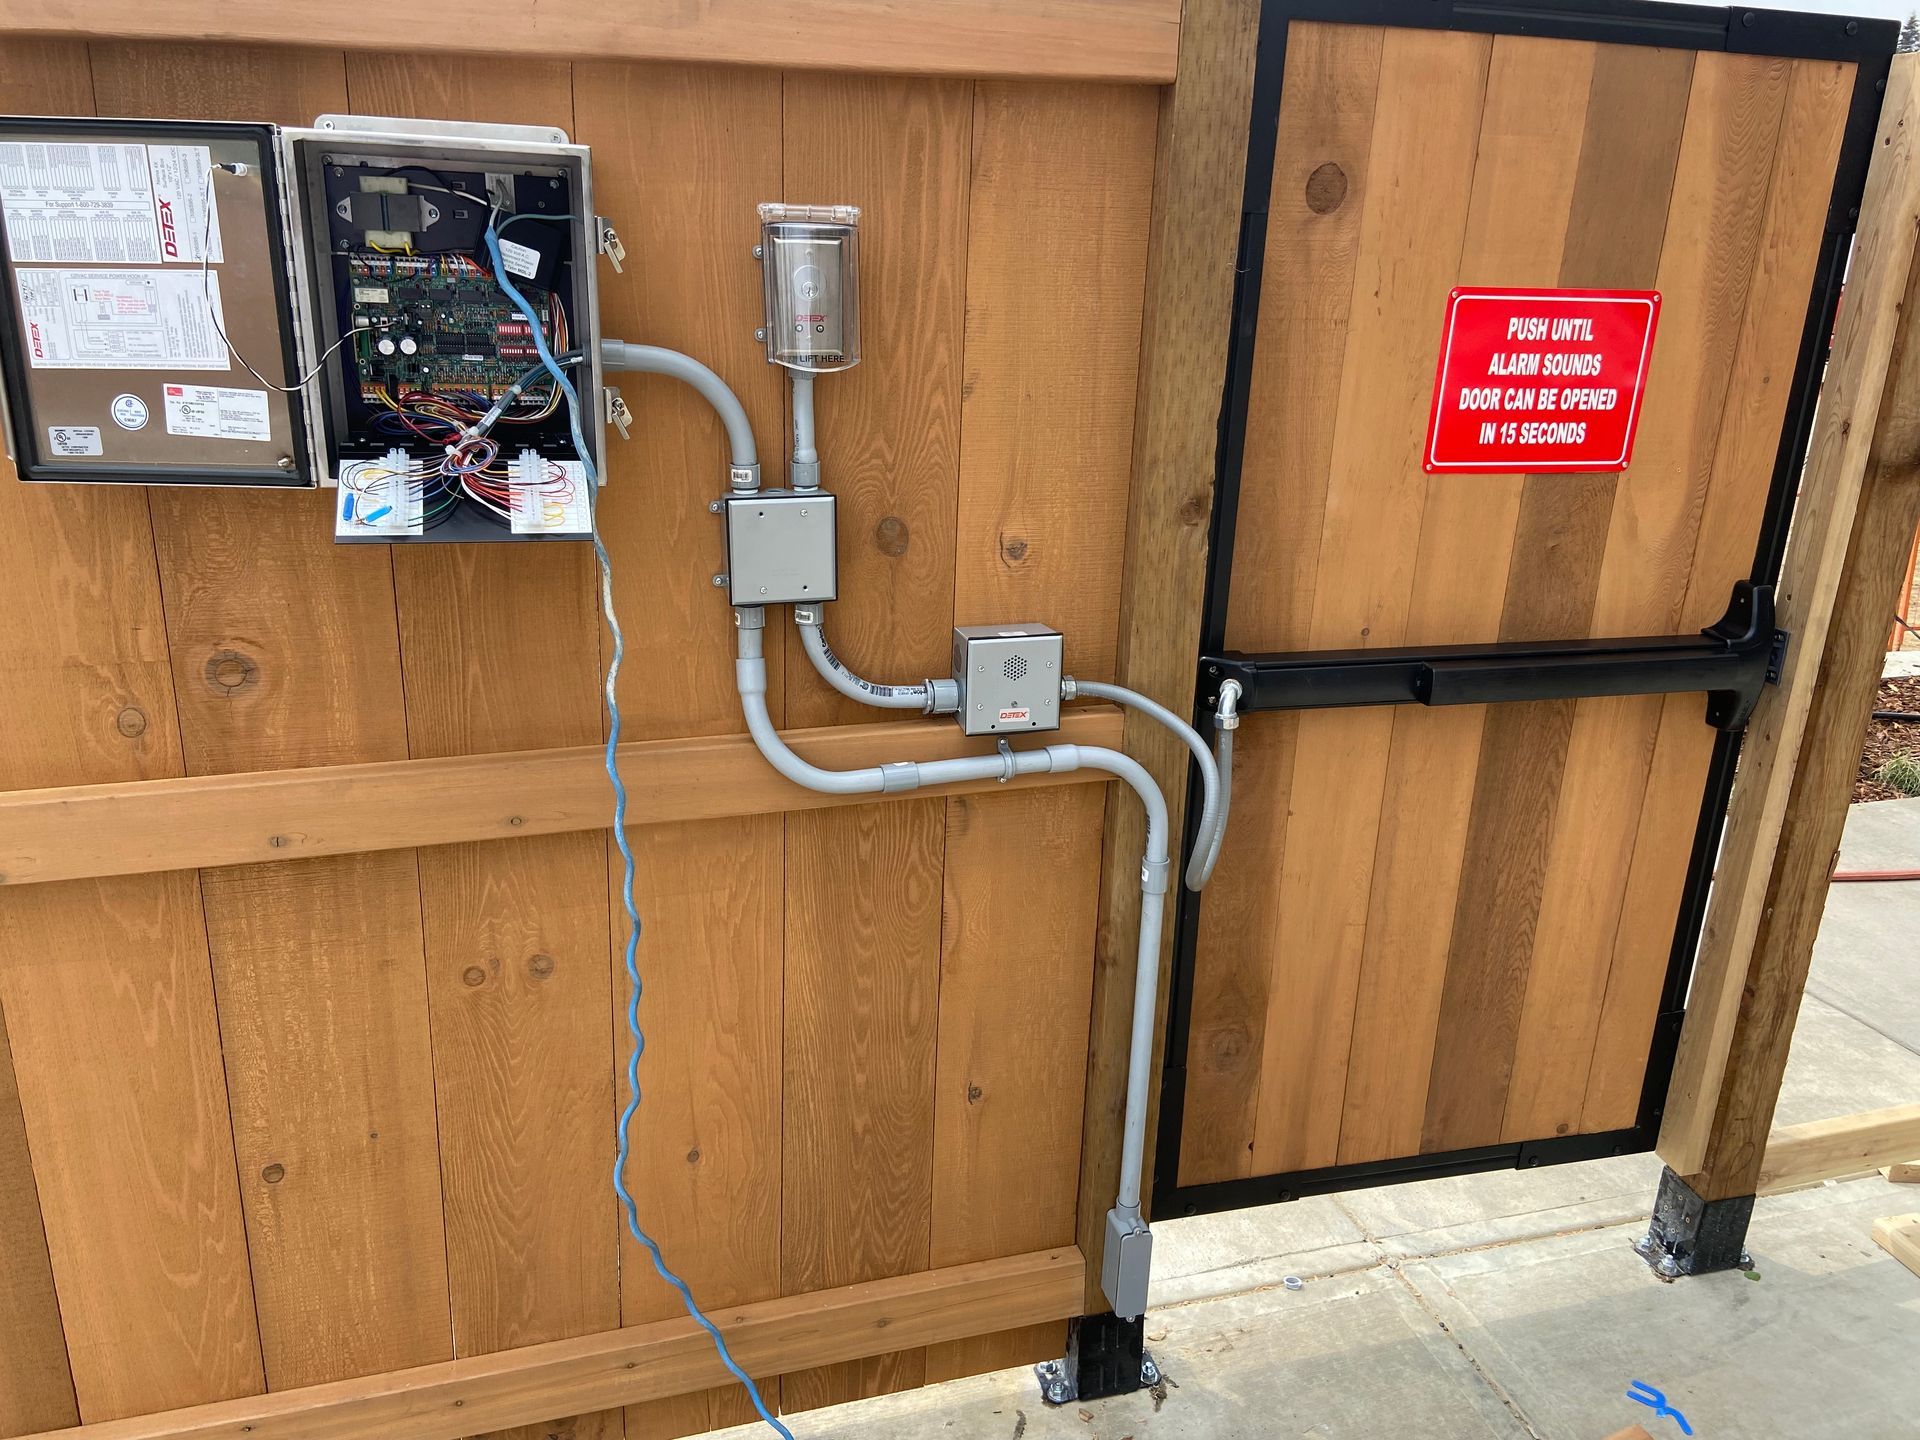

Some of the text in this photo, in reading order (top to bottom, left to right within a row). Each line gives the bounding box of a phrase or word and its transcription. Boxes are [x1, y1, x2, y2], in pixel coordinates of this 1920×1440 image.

[159, 198, 178, 258] DETEX
[795, 314, 827, 323] DETEX
[1507, 317, 1594, 341] PUSH UNTIL
[30, 321, 44, 359] DETEX
[800, 354, 845, 363] LIFT HERE
[1487, 352, 1602, 376] ALARM SOUNDS
[1458, 387, 1617, 411] DOOR CAN BE OPENED
[1479, 422, 1587, 444] IN 15 SECONDS
[1000, 711, 1028, 719] DETEX
